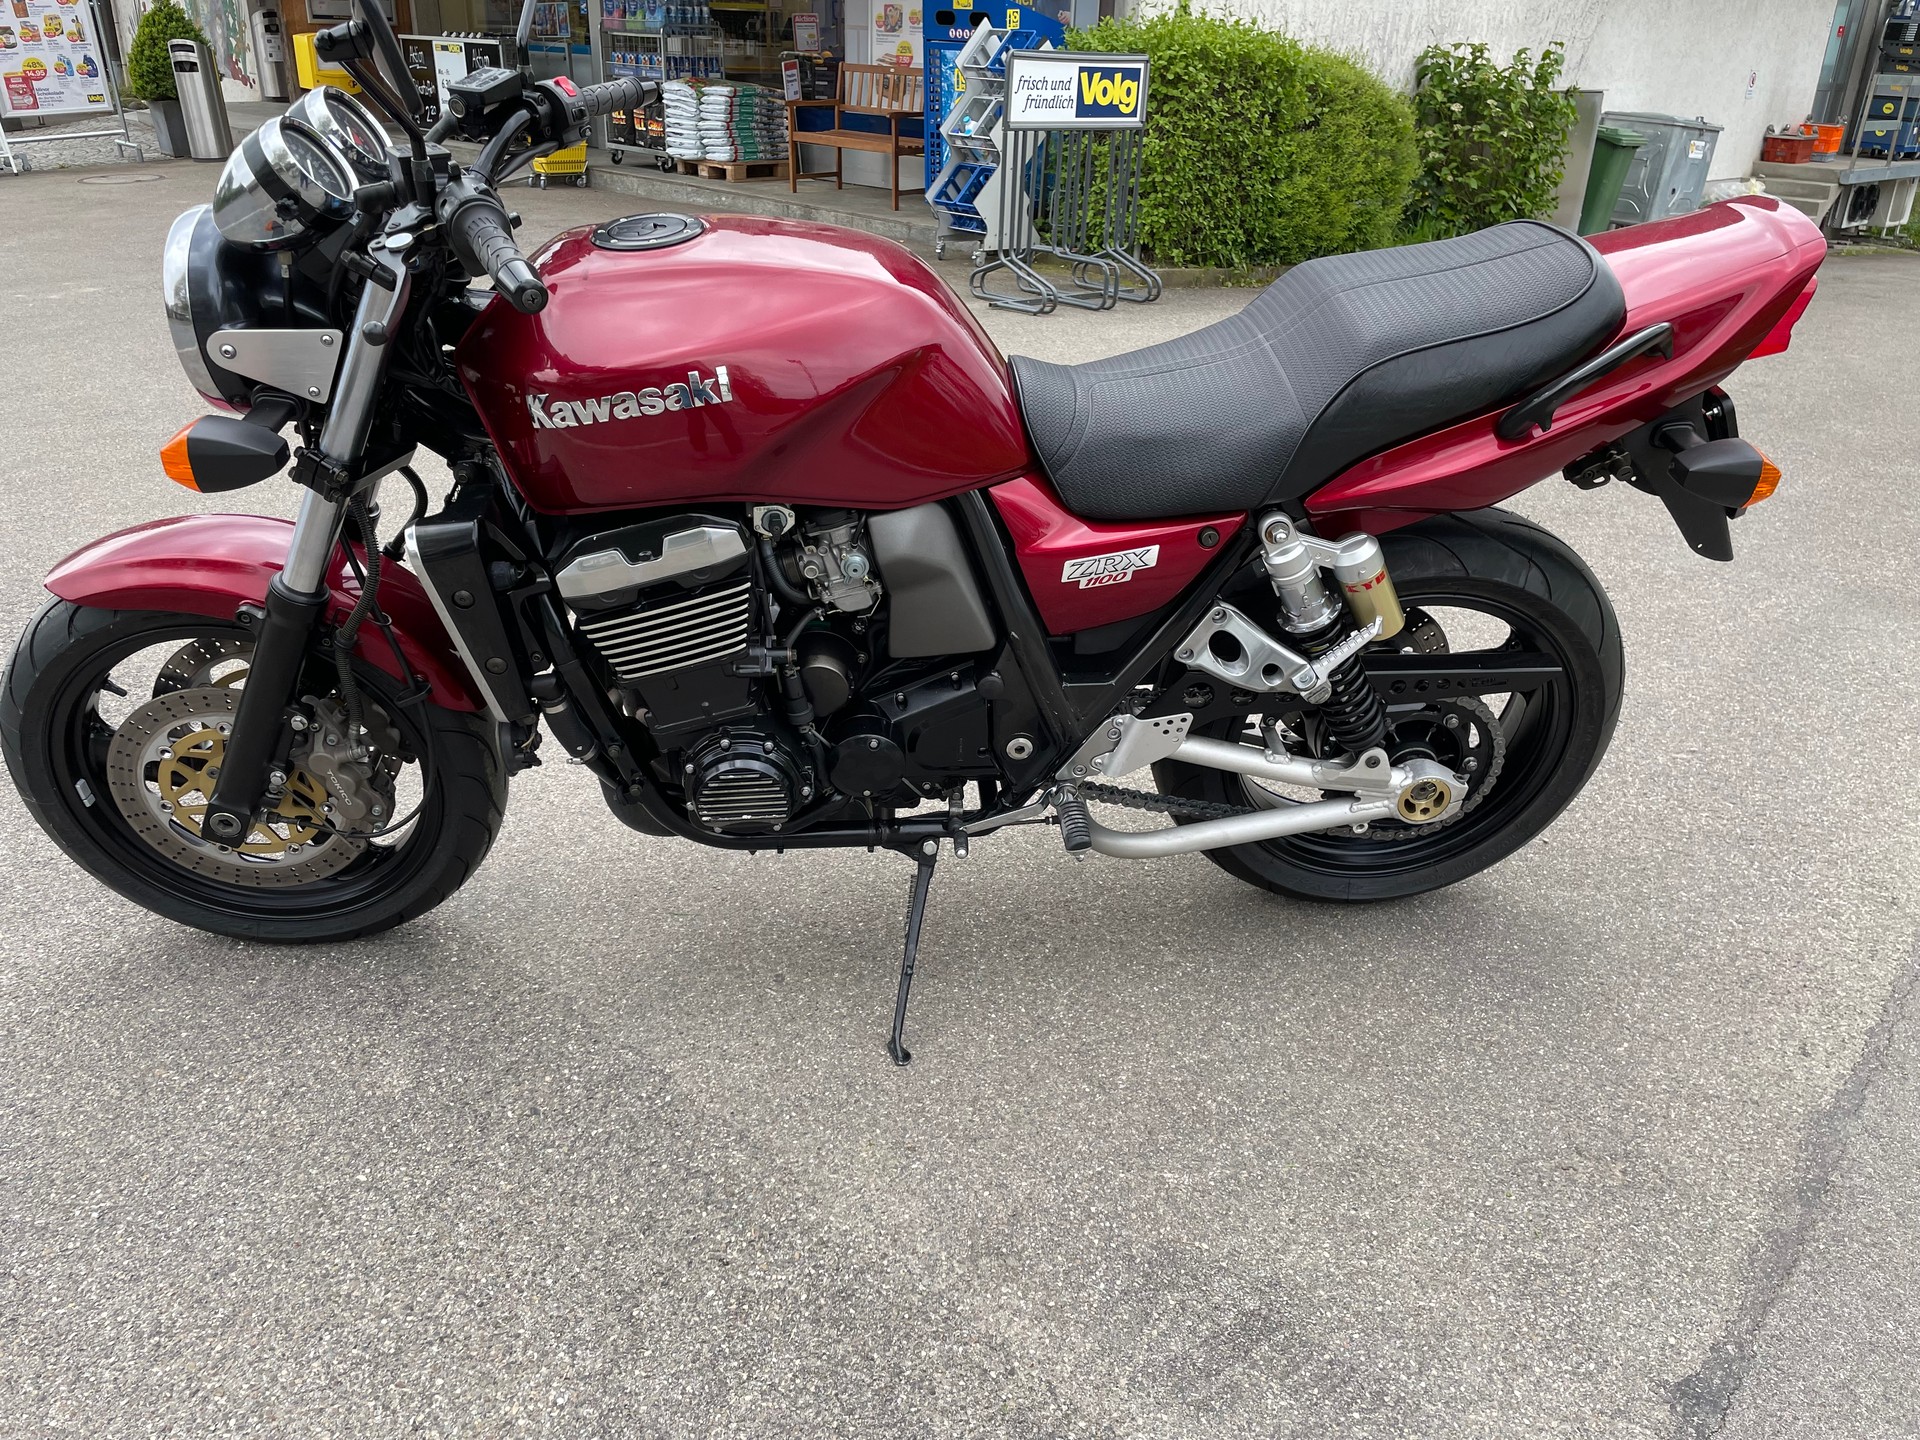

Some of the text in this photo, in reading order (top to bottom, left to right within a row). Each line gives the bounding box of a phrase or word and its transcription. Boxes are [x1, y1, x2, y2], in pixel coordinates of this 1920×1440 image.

[1014, 75, 1072, 94] frisch und
[1080, 72, 1138, 114] Volg
[1022, 94, 1073, 112] fründlich
[526, 366, 733, 429] Kawasaki
[1067, 549, 1151, 580] ZRX
[1085, 571, 1128, 587] 1100
[1346, 570, 1386, 593] KYB
[326, 769, 352, 806] TOKICO
